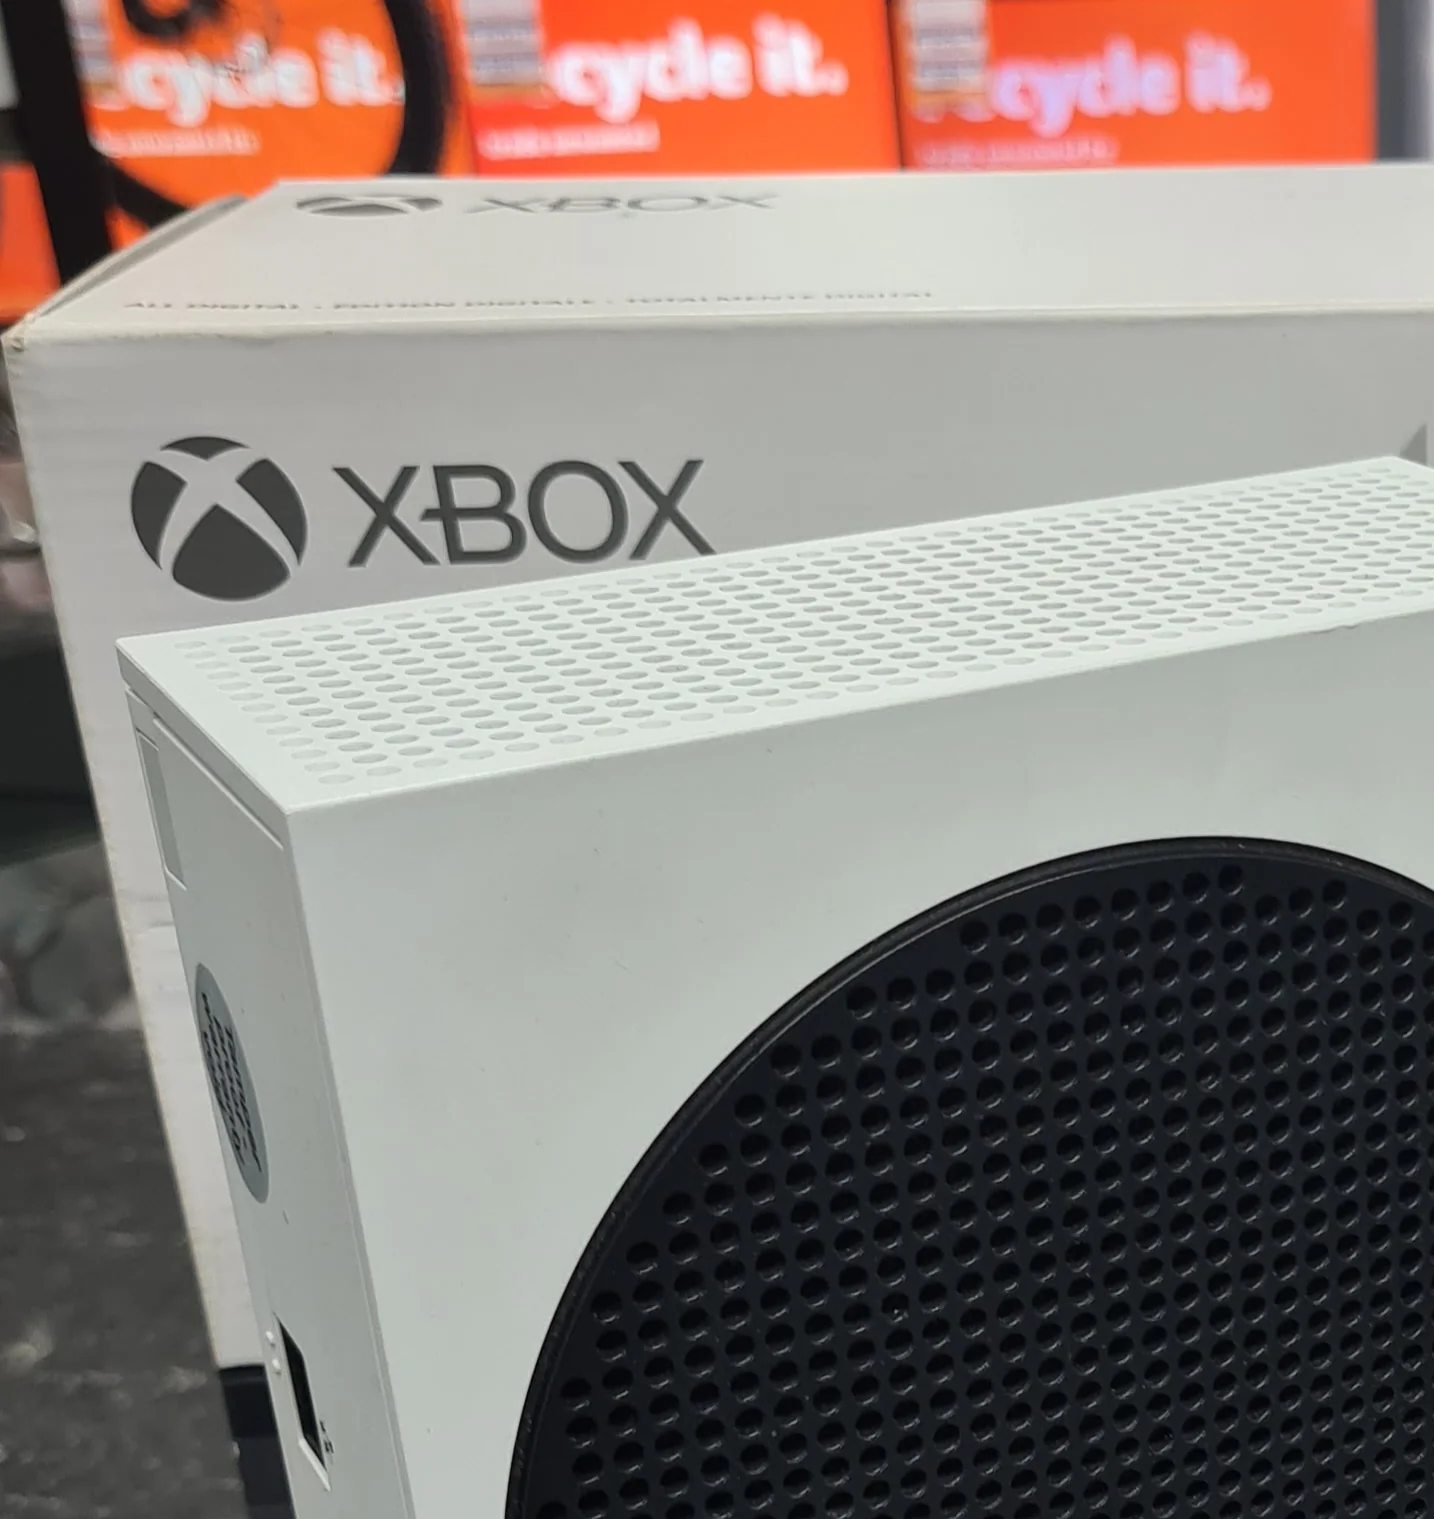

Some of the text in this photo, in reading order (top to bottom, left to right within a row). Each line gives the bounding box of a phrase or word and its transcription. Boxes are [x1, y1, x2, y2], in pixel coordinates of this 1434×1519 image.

[94, 32, 318, 127] cycle
[540, 16, 753, 124] cycle
[464, 196, 780, 214] XBOX
[331, 458, 717, 567] XBOX
[224, 1024, 262, 1173] Tamper
